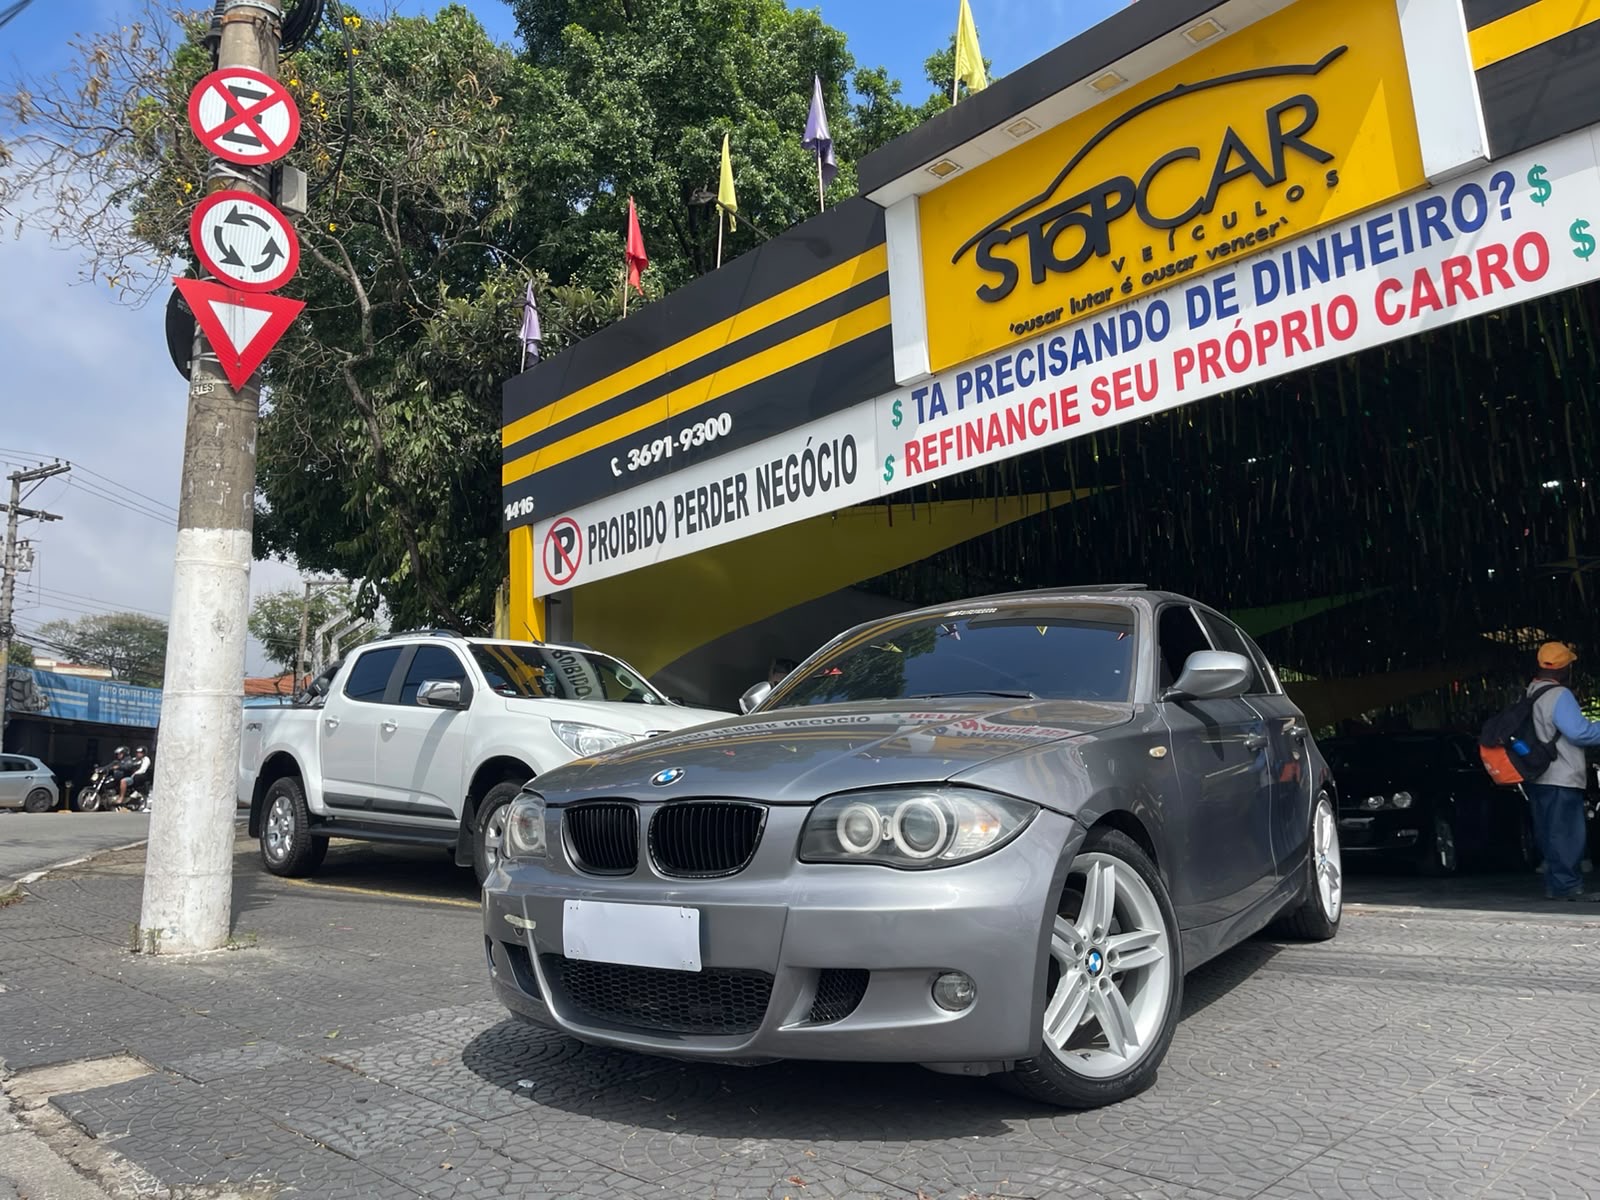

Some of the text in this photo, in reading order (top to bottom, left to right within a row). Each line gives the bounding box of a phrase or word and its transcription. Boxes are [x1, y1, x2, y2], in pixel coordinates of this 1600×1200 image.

[976, 93, 1335, 302] STOPCAR
[911, 382, 948, 425] TA
[956, 300, 1171, 411] PRECISANDO
[1185, 272, 1240, 330] DE
[1252, 170, 1516, 307] DINHEIRO?
[1070, 285, 1113, 314] lutar
[1120, 276, 1134, 294] é
[1141, 254, 1198, 285] ousar
[904, 385, 1081, 477] REFINANCIE
[1090, 358, 1159, 417] SEU
[1173, 294, 1358, 392] PRÓPRIO
[1374, 231, 1550, 326] CARRO
[588, 500, 667, 565] PROIBIDO
[674, 472, 750, 539] PERDER
[755, 433, 858, 512] NEGÓCIO
[626, 411, 733, 471] 3691-9300
[504, 496, 534, 521] 1416
